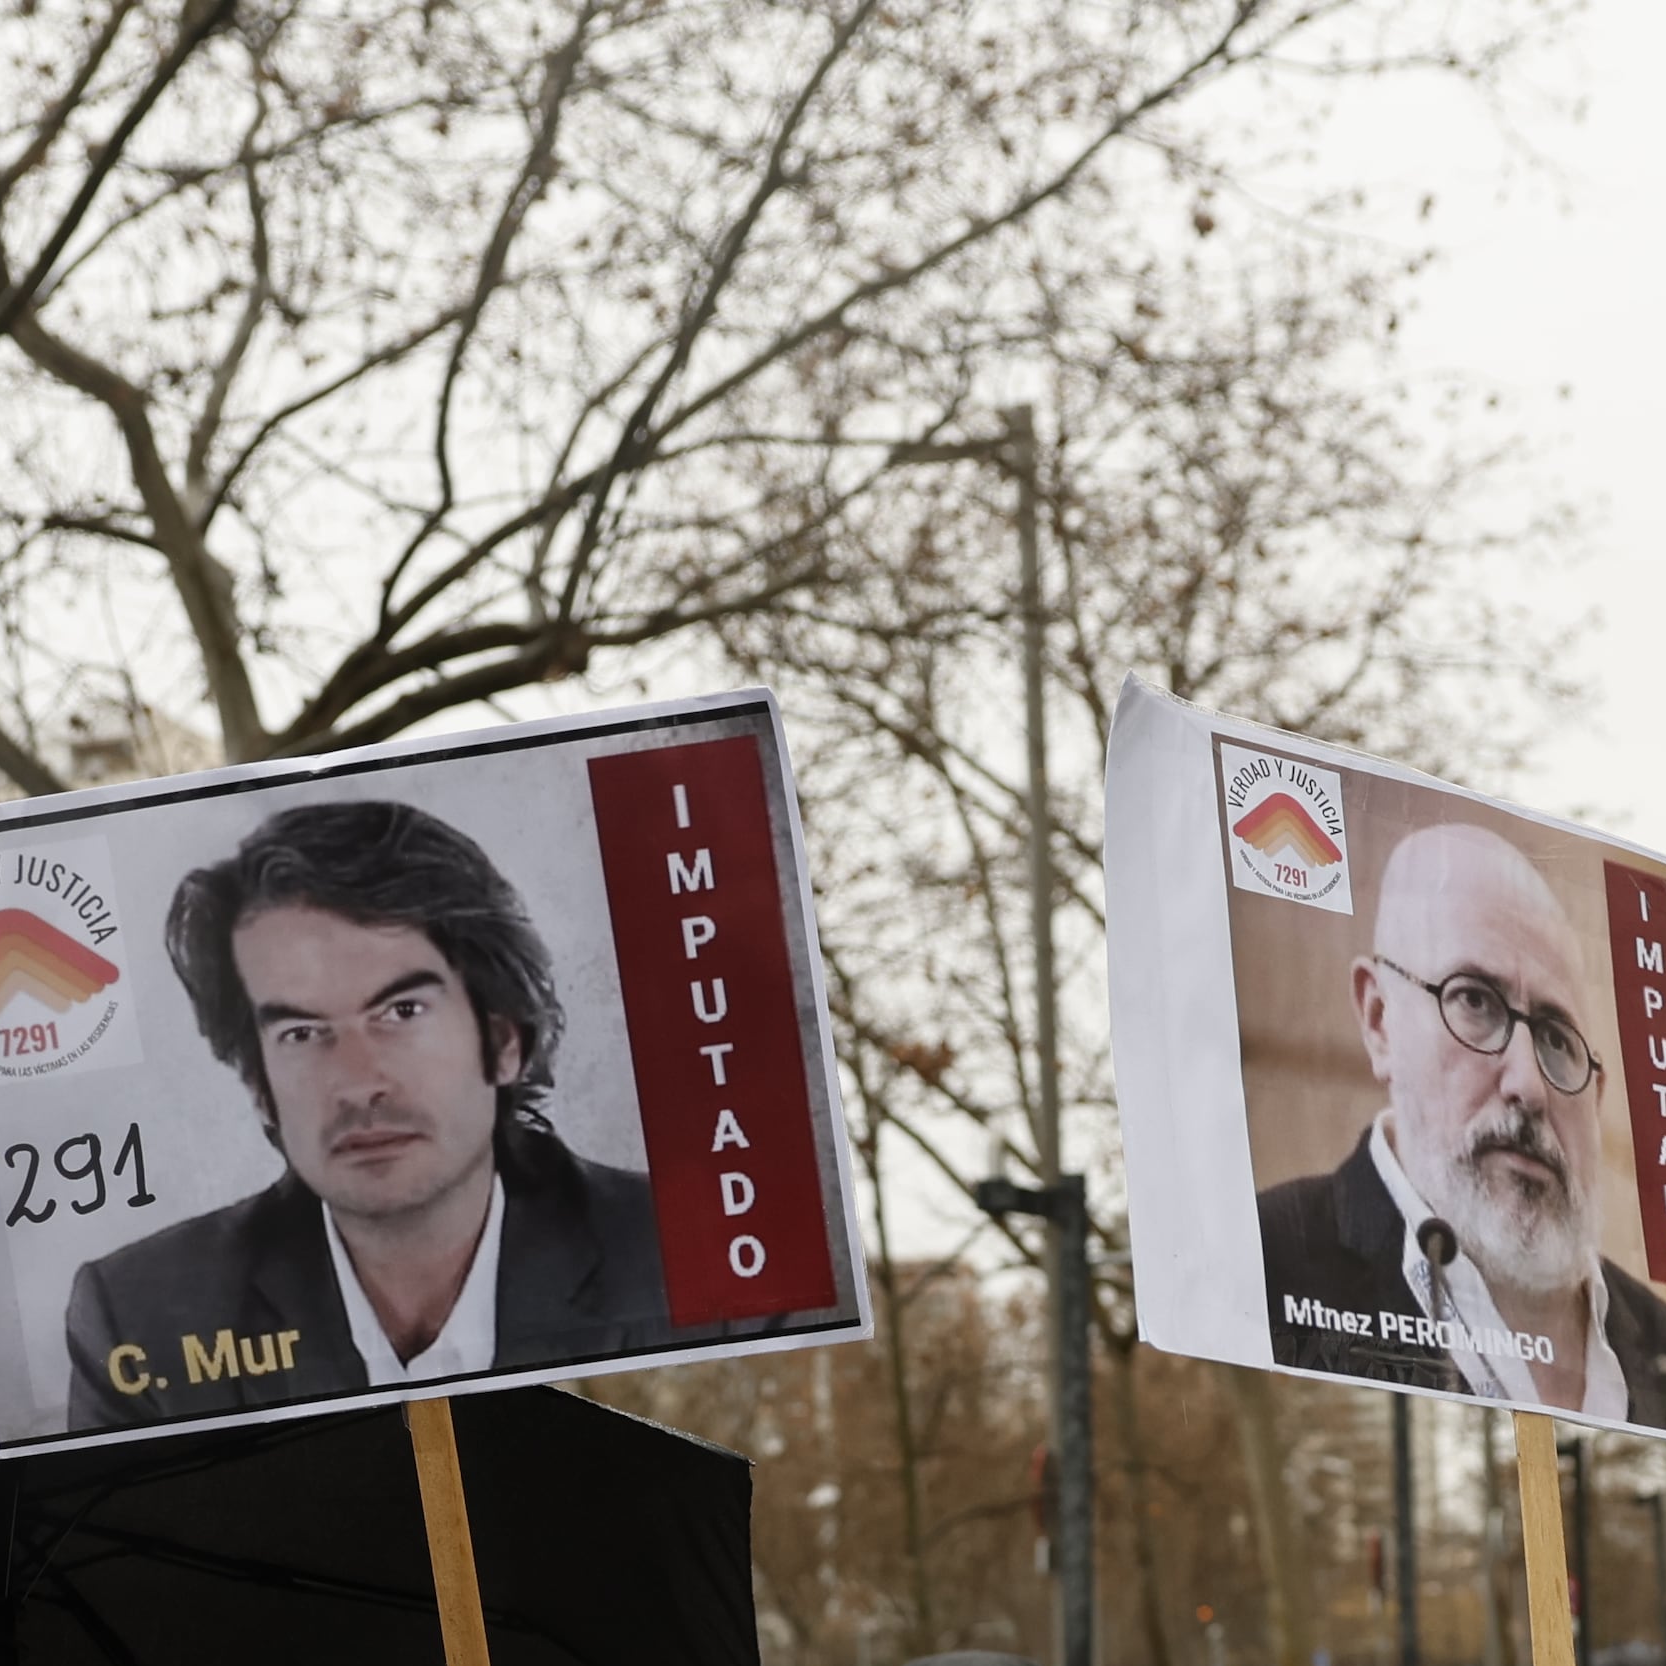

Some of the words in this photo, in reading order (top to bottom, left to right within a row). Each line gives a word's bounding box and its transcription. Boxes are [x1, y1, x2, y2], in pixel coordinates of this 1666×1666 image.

[1228, 758, 1271, 809] VERDAD
[1274, 758, 1283, 778] Y
[1288, 765, 1342, 836] JUSTICIA
[13, 854, 118, 945] JUSTICIA
[1274, 864, 1307, 888] 7291
[18, 1066, 32, 1077] LAS
[76, 1041, 90, 1056] LAS
[666, 784, 766, 1278] IMPUTADO
[107, 1344, 168, 1395] C.
[180, 1329, 300, 1384] Mur
[1283, 1294, 1373, 1337] Mtnez
[1379, 1310, 1555, 1364] PEROMINGO
